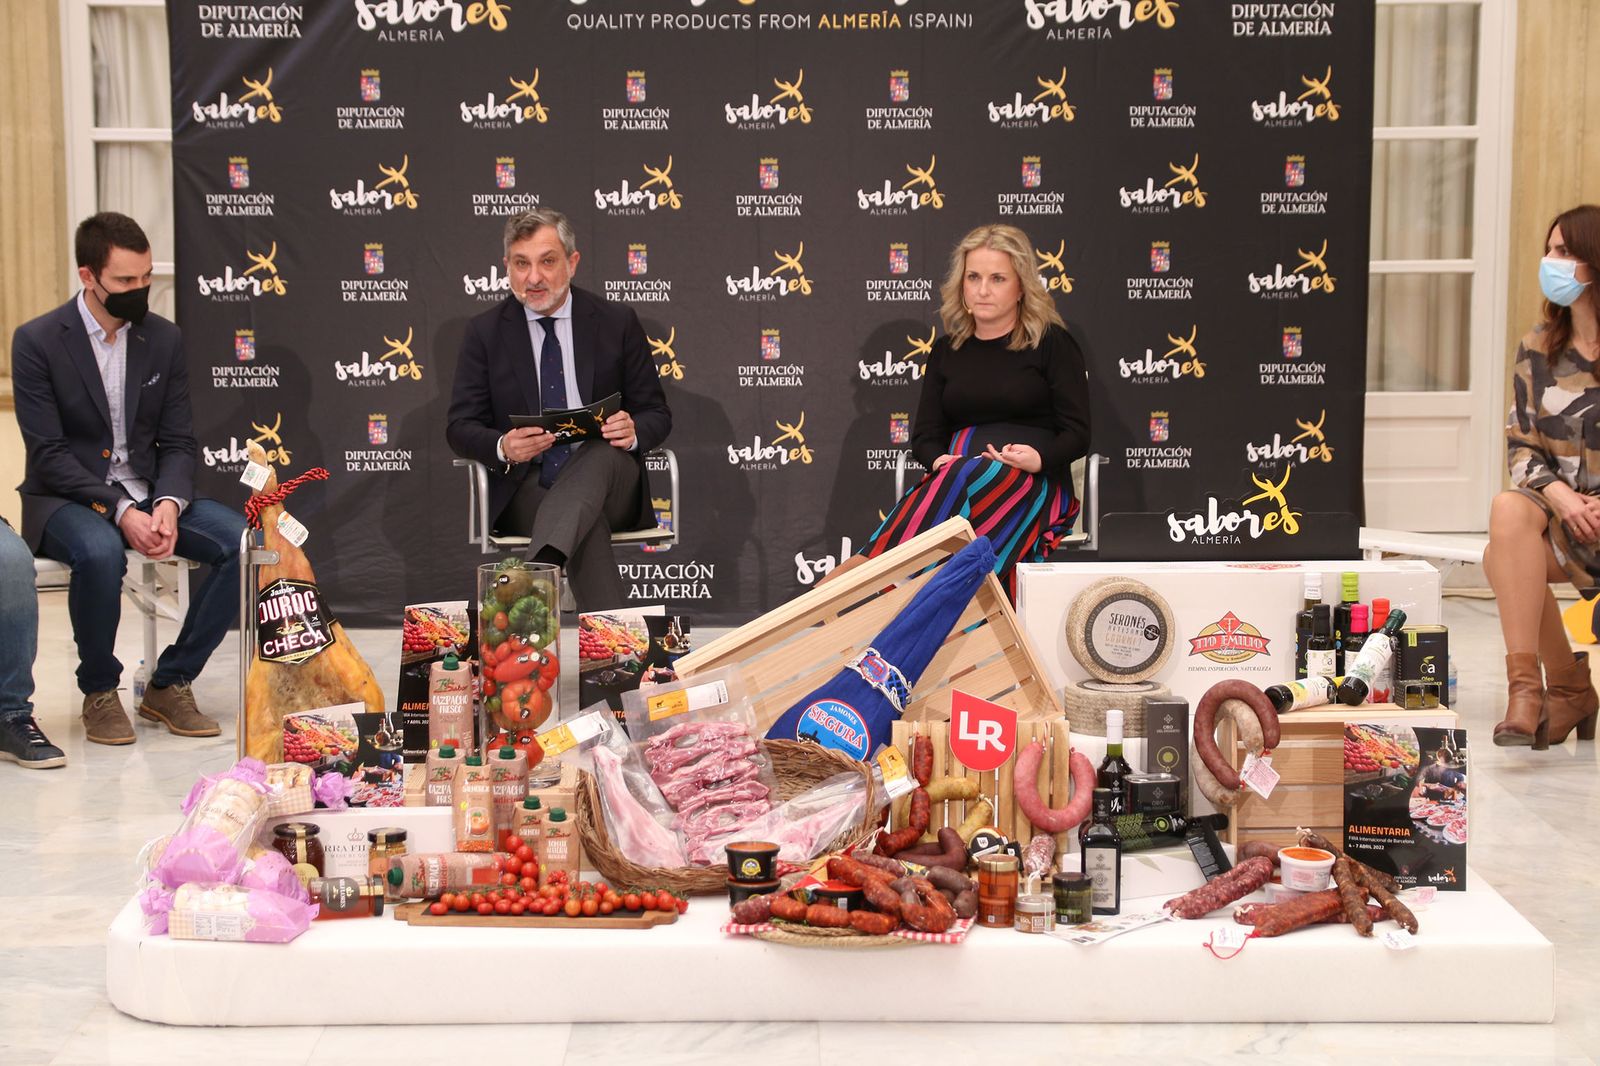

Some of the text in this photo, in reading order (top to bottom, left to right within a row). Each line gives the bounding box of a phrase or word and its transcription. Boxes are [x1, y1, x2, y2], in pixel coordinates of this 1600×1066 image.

[198, 2, 304, 21] DIPUTACIÓN
[1231, 1, 1335, 19] DIPUTACIÓN
[566, 11, 973, 31] QUALITY PRODUCTS FROM ALMERÍA (SPAIN)
[1233, 17, 1332, 37] DE ALMERÍA
[201, 18, 301, 39] DE ALMERÍA
[377, 27, 444, 42] ALMERÍA
[1045, 26, 1112, 40] ALMERÍA
[191, 92, 284, 124] sabores
[336, 105, 405, 118] DIPUTACIÓN
[459, 92, 551, 124] sabores
[602, 106, 670, 119] DIPUTACIÓN
[724, 93, 814, 124] sabores
[865, 106, 933, 119] DIPUTACIÓN
[987, 91, 1077, 123] sabores
[1129, 104, 1197, 117] DIPUTACIÓN
[1251, 90, 1342, 122] sabores
[205, 119, 245, 129] ALMERÍA
[338, 116, 404, 129] DE ALMERÍA
[472, 119, 512, 129] ALMERÍA
[604, 118, 669, 131] DE ALMERÍA
[737, 121, 776, 130] ALMERÍA
[867, 118, 932, 130] DE ALMERÍA
[1000, 119, 1039, 129] ALMERÍA
[1130, 115, 1195, 129] DE ALMERÍA
[1264, 118, 1303, 128] ALMERÍA
[205, 192, 274, 205] DIPUTACIÓN
[329, 179, 420, 210] sabores
[472, 192, 540, 205] DIPUTACIÓN
[594, 179, 683, 211] sabores
[735, 193, 803, 206] DIPUTACIÓN
[856, 179, 946, 211] sabores
[998, 191, 1065, 204] DIPUTACIÓN
[1119, 177, 1207, 209] sabores
[1260, 190, 1328, 204] DIPUTACIÓN
[207, 204, 274, 216] DE ALMERÍA
[343, 207, 382, 216] ALMERÍA
[474, 207, 489, 216] DE
[607, 206, 646, 216] ALMERÍA
[736, 204, 802, 217] DE ALMERÍA
[870, 206, 908, 216] ALMERÍA
[999, 202, 1063, 216] DE ALMERÍA
[1131, 205, 1170, 214] ALMERÍA
[1261, 202, 1326, 215] DE ALMERÍA
[197, 265, 289, 297] sabores
[341, 278, 409, 291] DIPUTACIÓN
[463, 265, 511, 293] sabo
[604, 278, 672, 291] DIPUTACIÓN
[725, 265, 814, 297] sabores
[865, 278, 933, 291] DIPUTACIÓN
[1126, 276, 1194, 289] DIPUTACIÓN
[1247, 262, 1337, 294] sabores
[211, 293, 251, 302] ALMERÍA
[342, 289, 408, 302] DE ALMERÍA
[606, 289, 671, 302] DE ALMERÍA
[738, 293, 777, 302] ALMERÍA
[867, 289, 932, 301] DE ALMERÍA
[1128, 287, 1193, 299] DE ALMERÍA
[1260, 290, 1300, 299] ALMERÍA
[334, 350, 424, 382] sabores
[738, 364, 805, 376] DIPUTACIÓN
[1118, 348, 1207, 379] sabores
[1258, 361, 1326, 374] DIPUTACIÓN
[211, 364, 280, 377] DIPUTACIÓN
[213, 375, 279, 388] DE ALMERÍA
[347, 378, 387, 387] ALMERÍA
[739, 375, 804, 387] DE ALMERÍA
[870, 377, 909, 386] ALMERÍA
[1131, 375, 1170, 384] ALMERÍA
[1260, 372, 1325, 385] DE ALMERÍA
[344, 448, 412, 461] DIPUTACIÓN
[727, 435, 815, 465] sabores
[1125, 446, 1192, 458] DIPUTACIÓN
[1246, 432, 1335, 464] sabores
[346, 459, 411, 472] DE ALMERÍA
[739, 462, 778, 471] ALMERÍA
[867, 462, 884, 470] DE
[1126, 456, 1191, 469] DE ALMERÍA
[1166, 496, 1302, 543] sabores
[1191, 534, 1241, 545] ALMERÍA
[270, 585, 296, 597] Jamón
[627, 579, 713, 600] ALMERÍA
[1108, 612, 1147, 629] SERONÉS
[263, 629, 327, 656] CHECA
[1221, 635, 1263, 649] EMILIO
[829, 704, 858, 725] JAMONES
[807, 705, 864, 750] SEGURA
[958, 710, 1007, 752] LR
[1348, 824, 1411, 836] ALIMENTARIA
